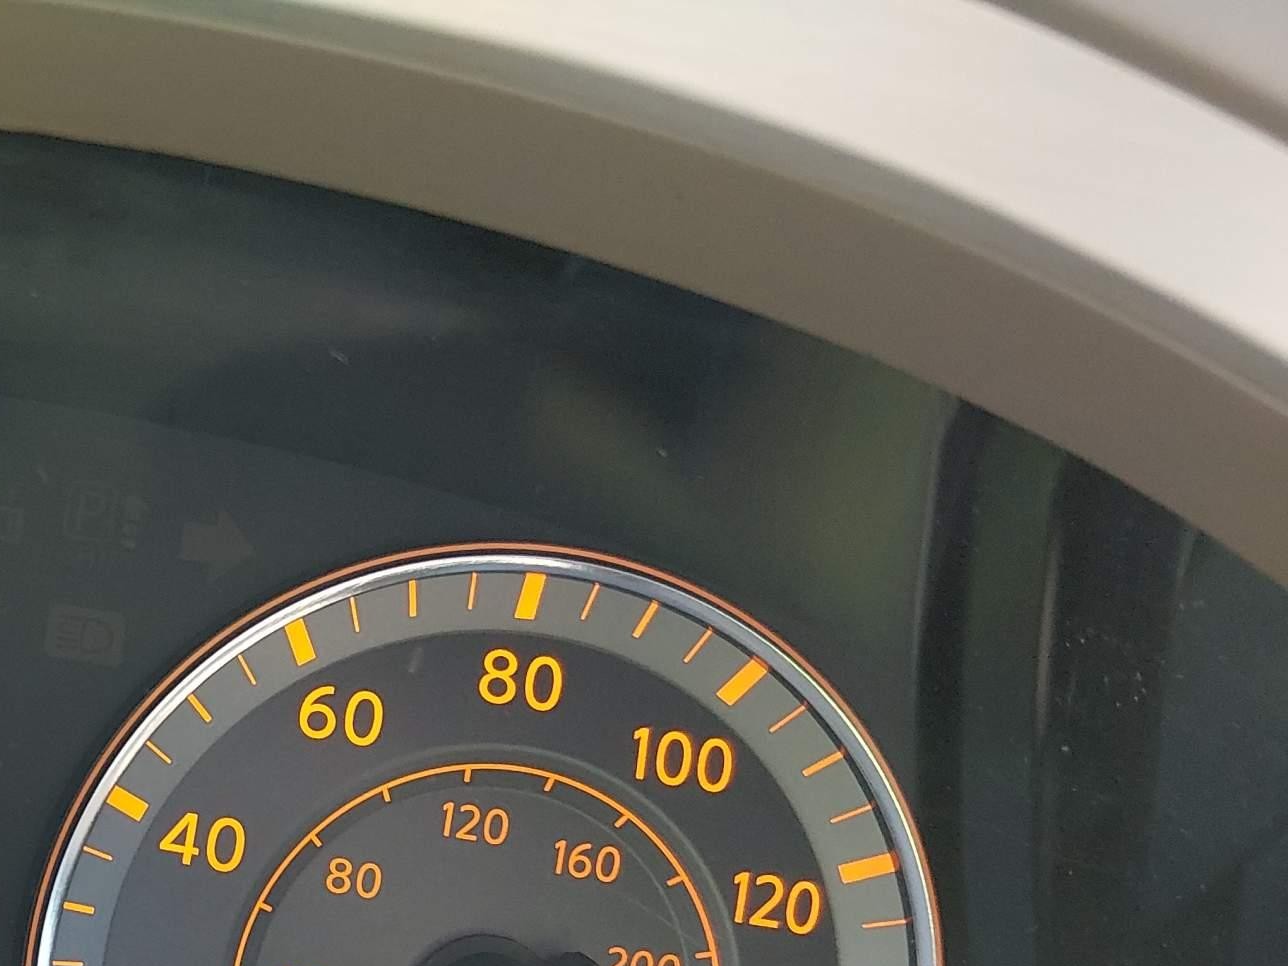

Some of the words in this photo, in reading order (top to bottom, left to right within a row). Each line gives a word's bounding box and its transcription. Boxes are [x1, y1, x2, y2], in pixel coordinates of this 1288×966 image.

[478, 649, 563, 711] 80
[299, 686, 384, 746] 60
[632, 727, 733, 793] 100
[158, 812, 246, 872] 40
[441, 801, 509, 846] 120
[325, 857, 383, 899] 80
[554, 839, 621, 883] 160
[732, 871, 821, 935] 120
